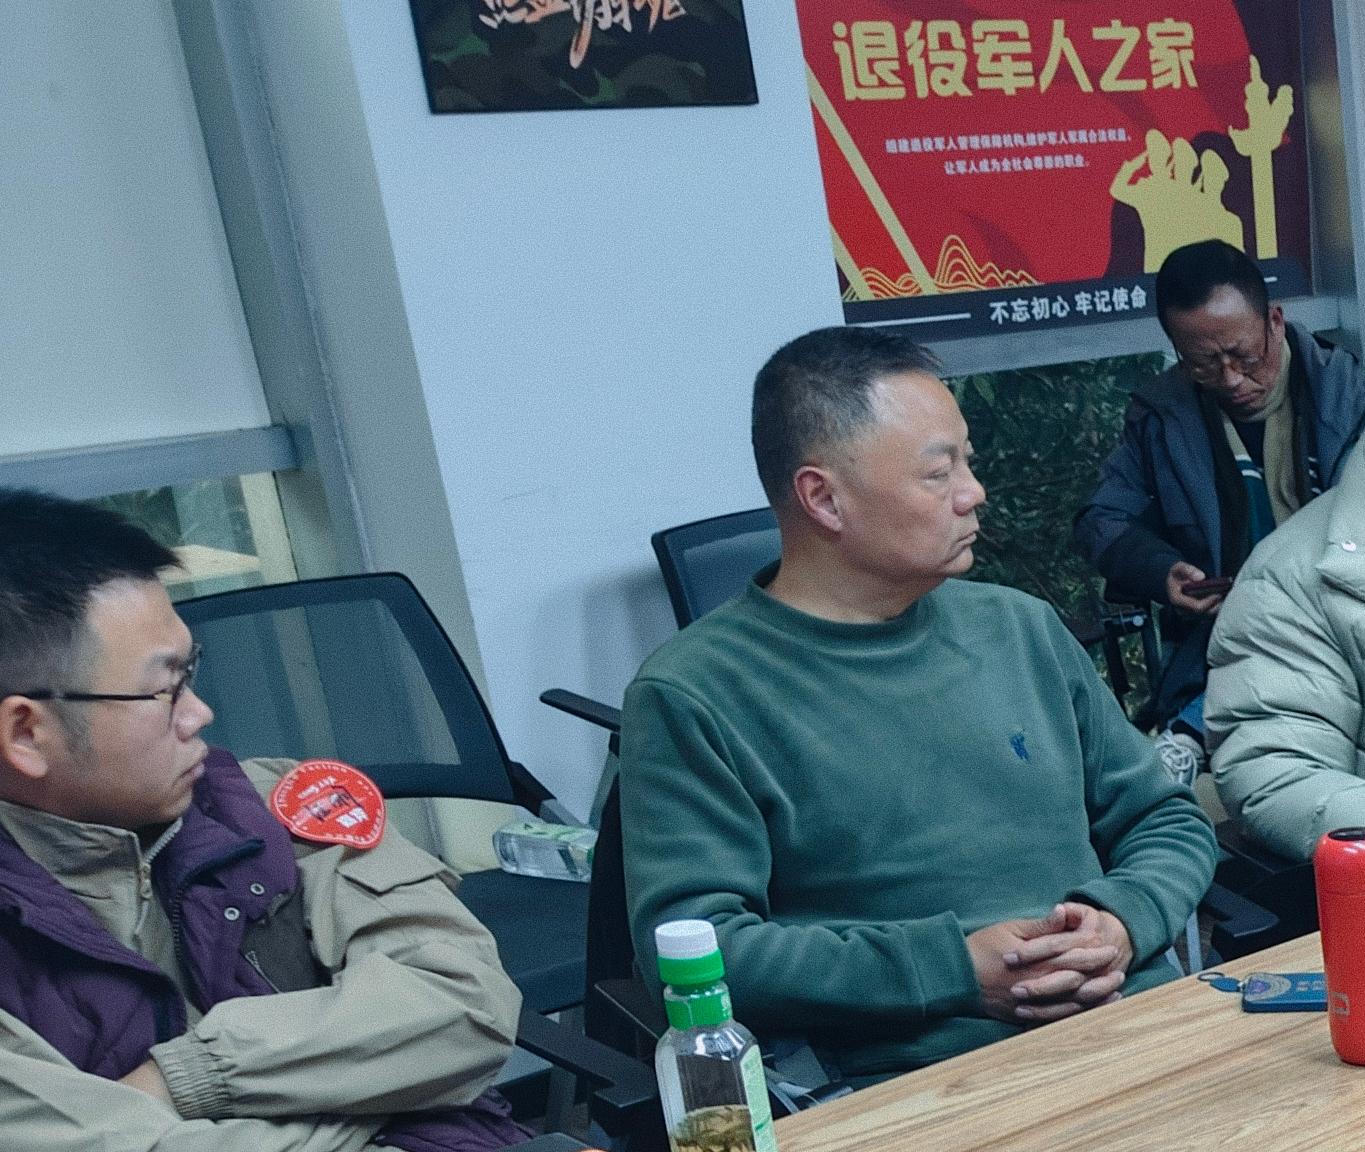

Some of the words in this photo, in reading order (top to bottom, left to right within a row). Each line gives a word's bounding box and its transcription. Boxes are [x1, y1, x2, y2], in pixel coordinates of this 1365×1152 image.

[832, 18, 1199, 101] 退役军人之家
[989, 295, 1071, 325] 不忘初心
[1074, 285, 1147, 316] 牢记使命
